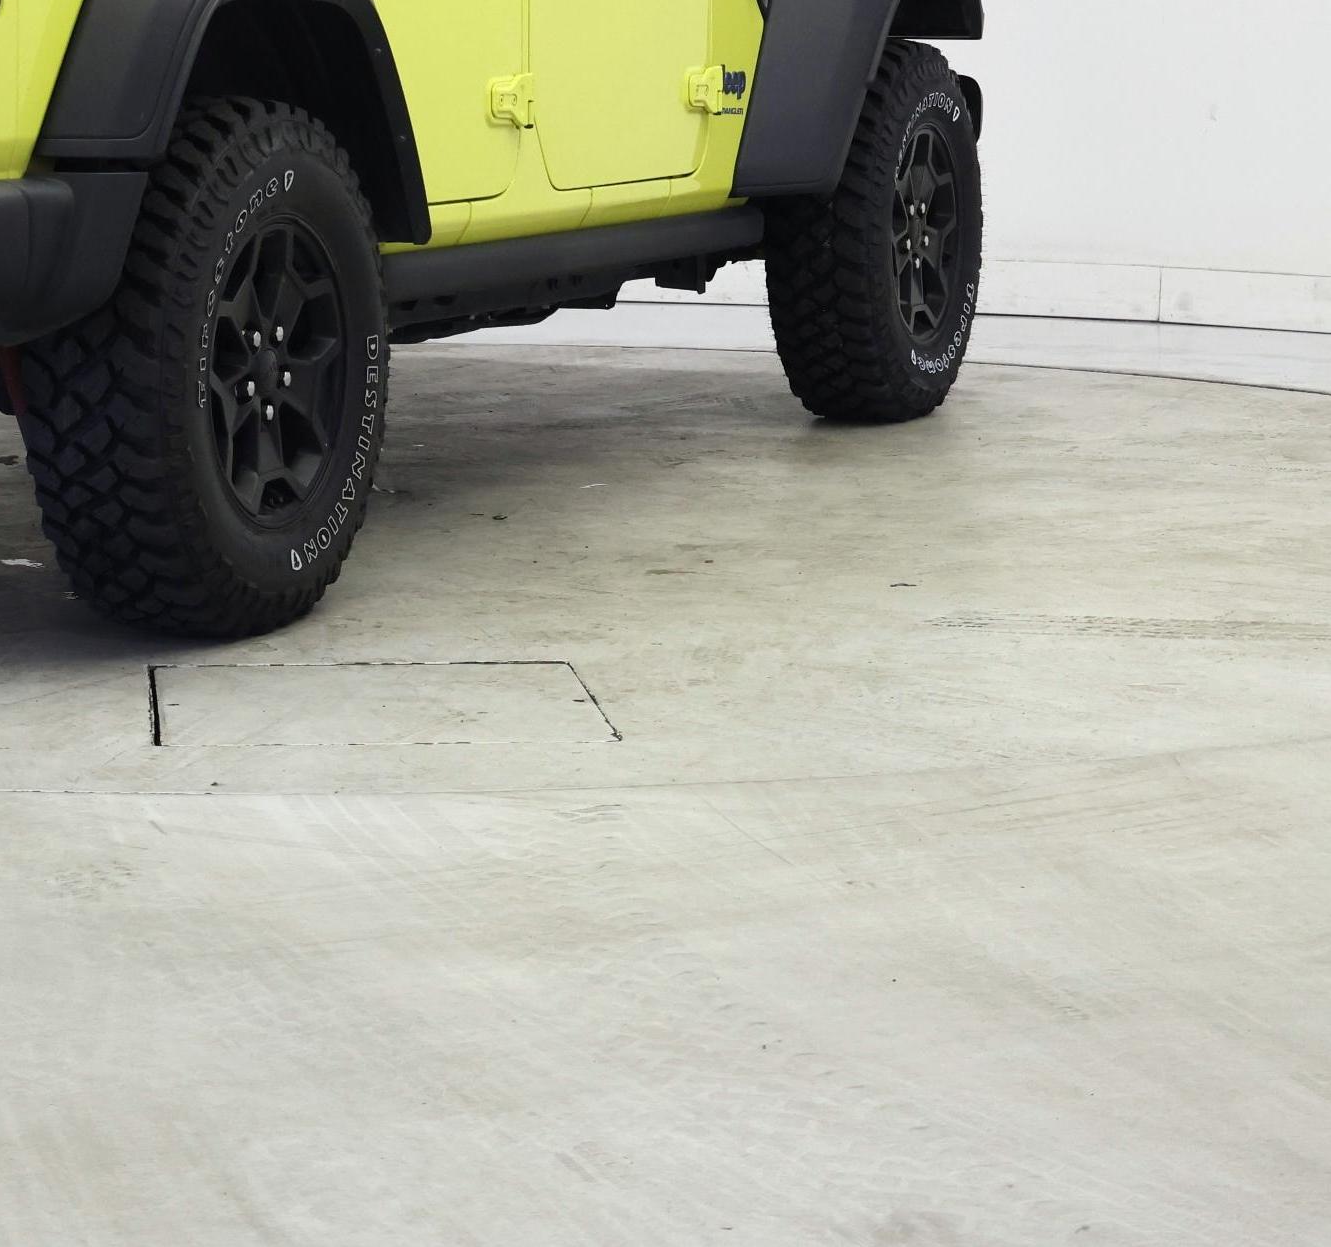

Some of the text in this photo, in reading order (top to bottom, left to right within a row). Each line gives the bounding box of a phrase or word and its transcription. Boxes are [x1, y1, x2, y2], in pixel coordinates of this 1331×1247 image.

[197, 175, 280, 409] Firestone
[918, 283, 975, 374] Firestone
[303, 335, 379, 564] DESTINATION
